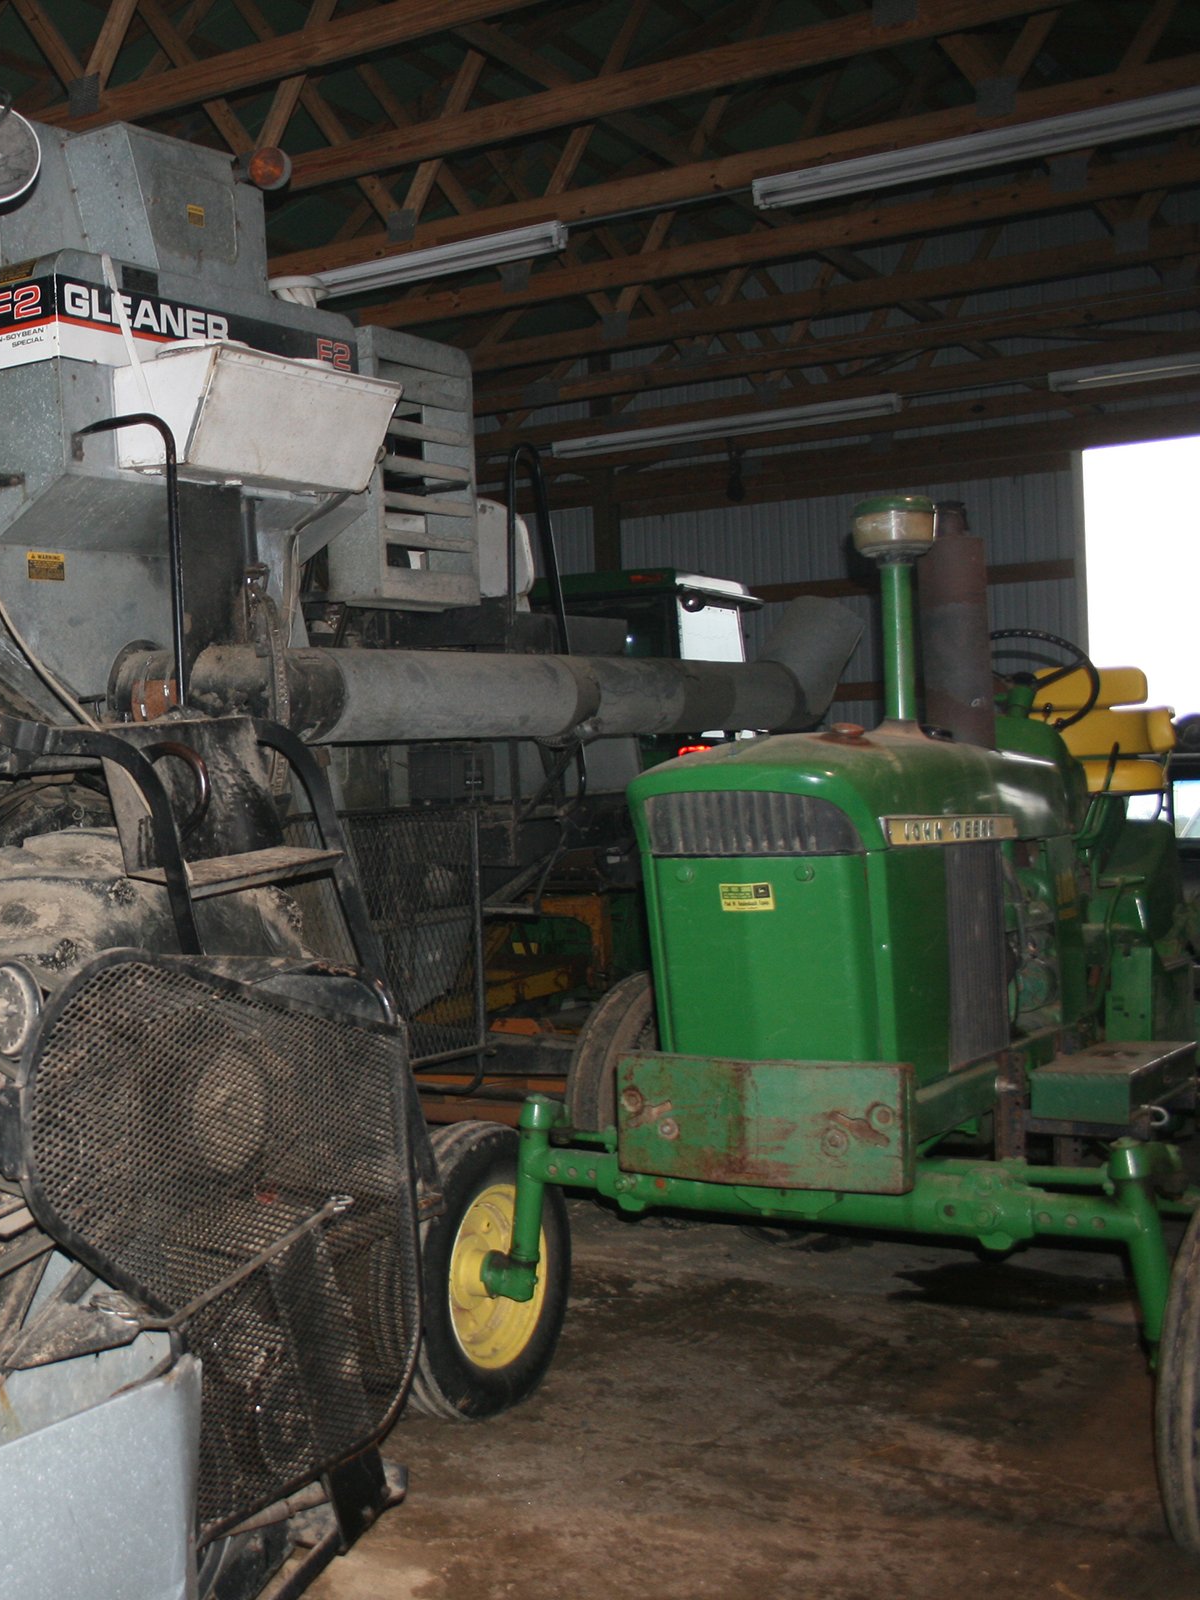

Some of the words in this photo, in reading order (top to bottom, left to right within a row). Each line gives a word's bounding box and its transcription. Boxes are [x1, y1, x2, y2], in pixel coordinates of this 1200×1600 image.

[64, 282, 229, 341] GLEANER
[11, 336, 44, 348] SPECIAL
[317, 338, 352, 372] F2
[904, 821, 942, 841] JOHN
[952, 819, 994, 840] DEERE
